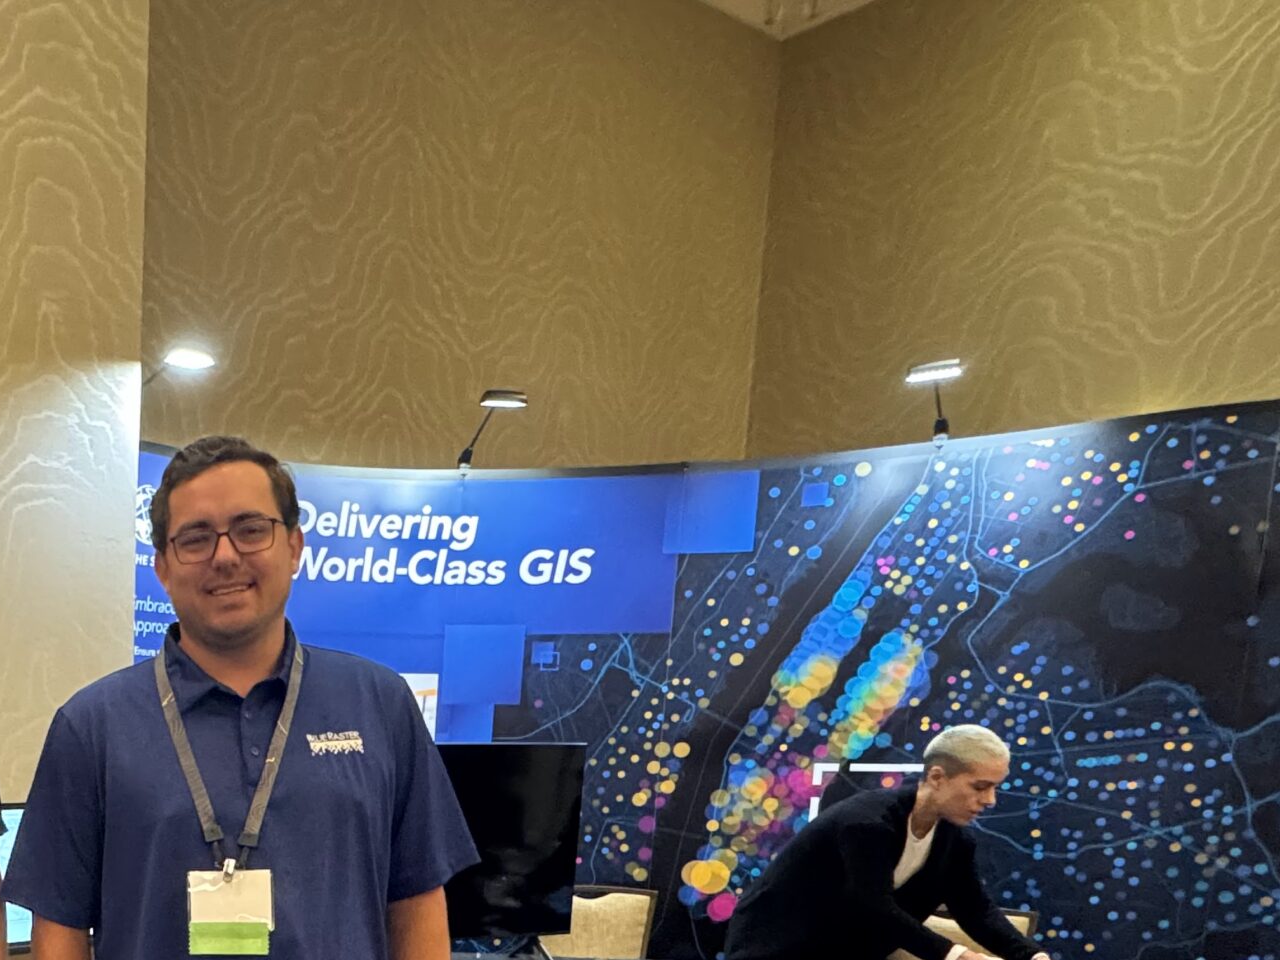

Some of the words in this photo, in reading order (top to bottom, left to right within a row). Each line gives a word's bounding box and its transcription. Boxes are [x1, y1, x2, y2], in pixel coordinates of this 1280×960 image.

[298, 500, 479, 551] Delivering
[135, 554, 149, 567] HE
[293, 546, 507, 586] World-Class
[519, 548, 596, 586] GIS
